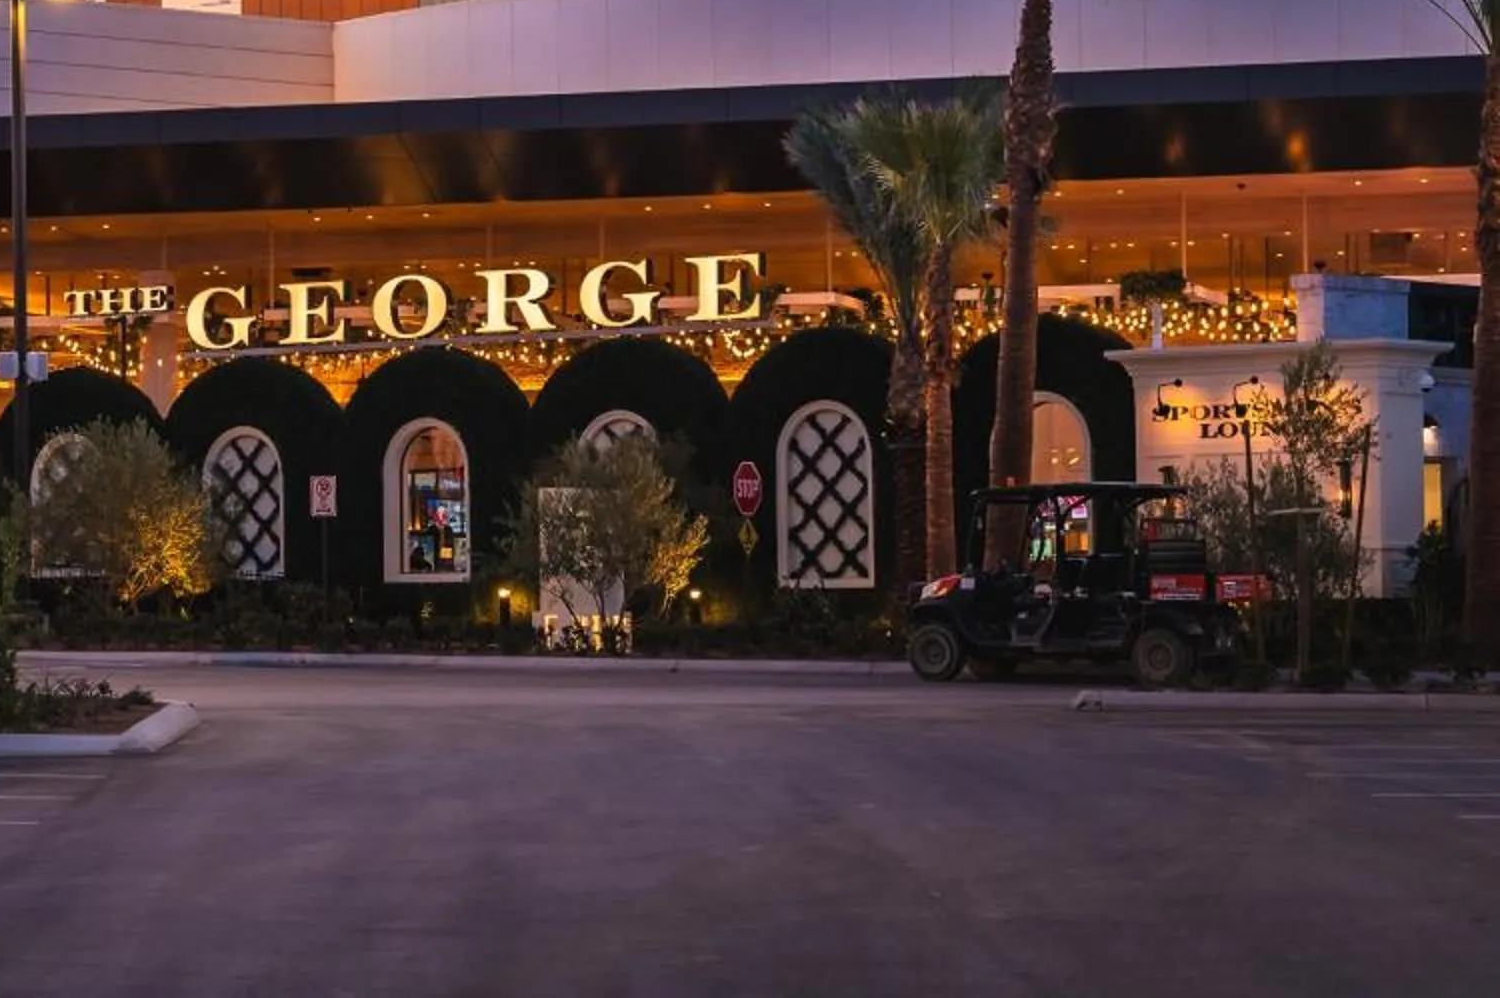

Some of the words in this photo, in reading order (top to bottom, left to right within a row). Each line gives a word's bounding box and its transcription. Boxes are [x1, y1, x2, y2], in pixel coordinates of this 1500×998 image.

[63, 285, 170, 316] THE
[187, 252, 765, 350] GEORGE
[737, 479, 759, 499] STOP
